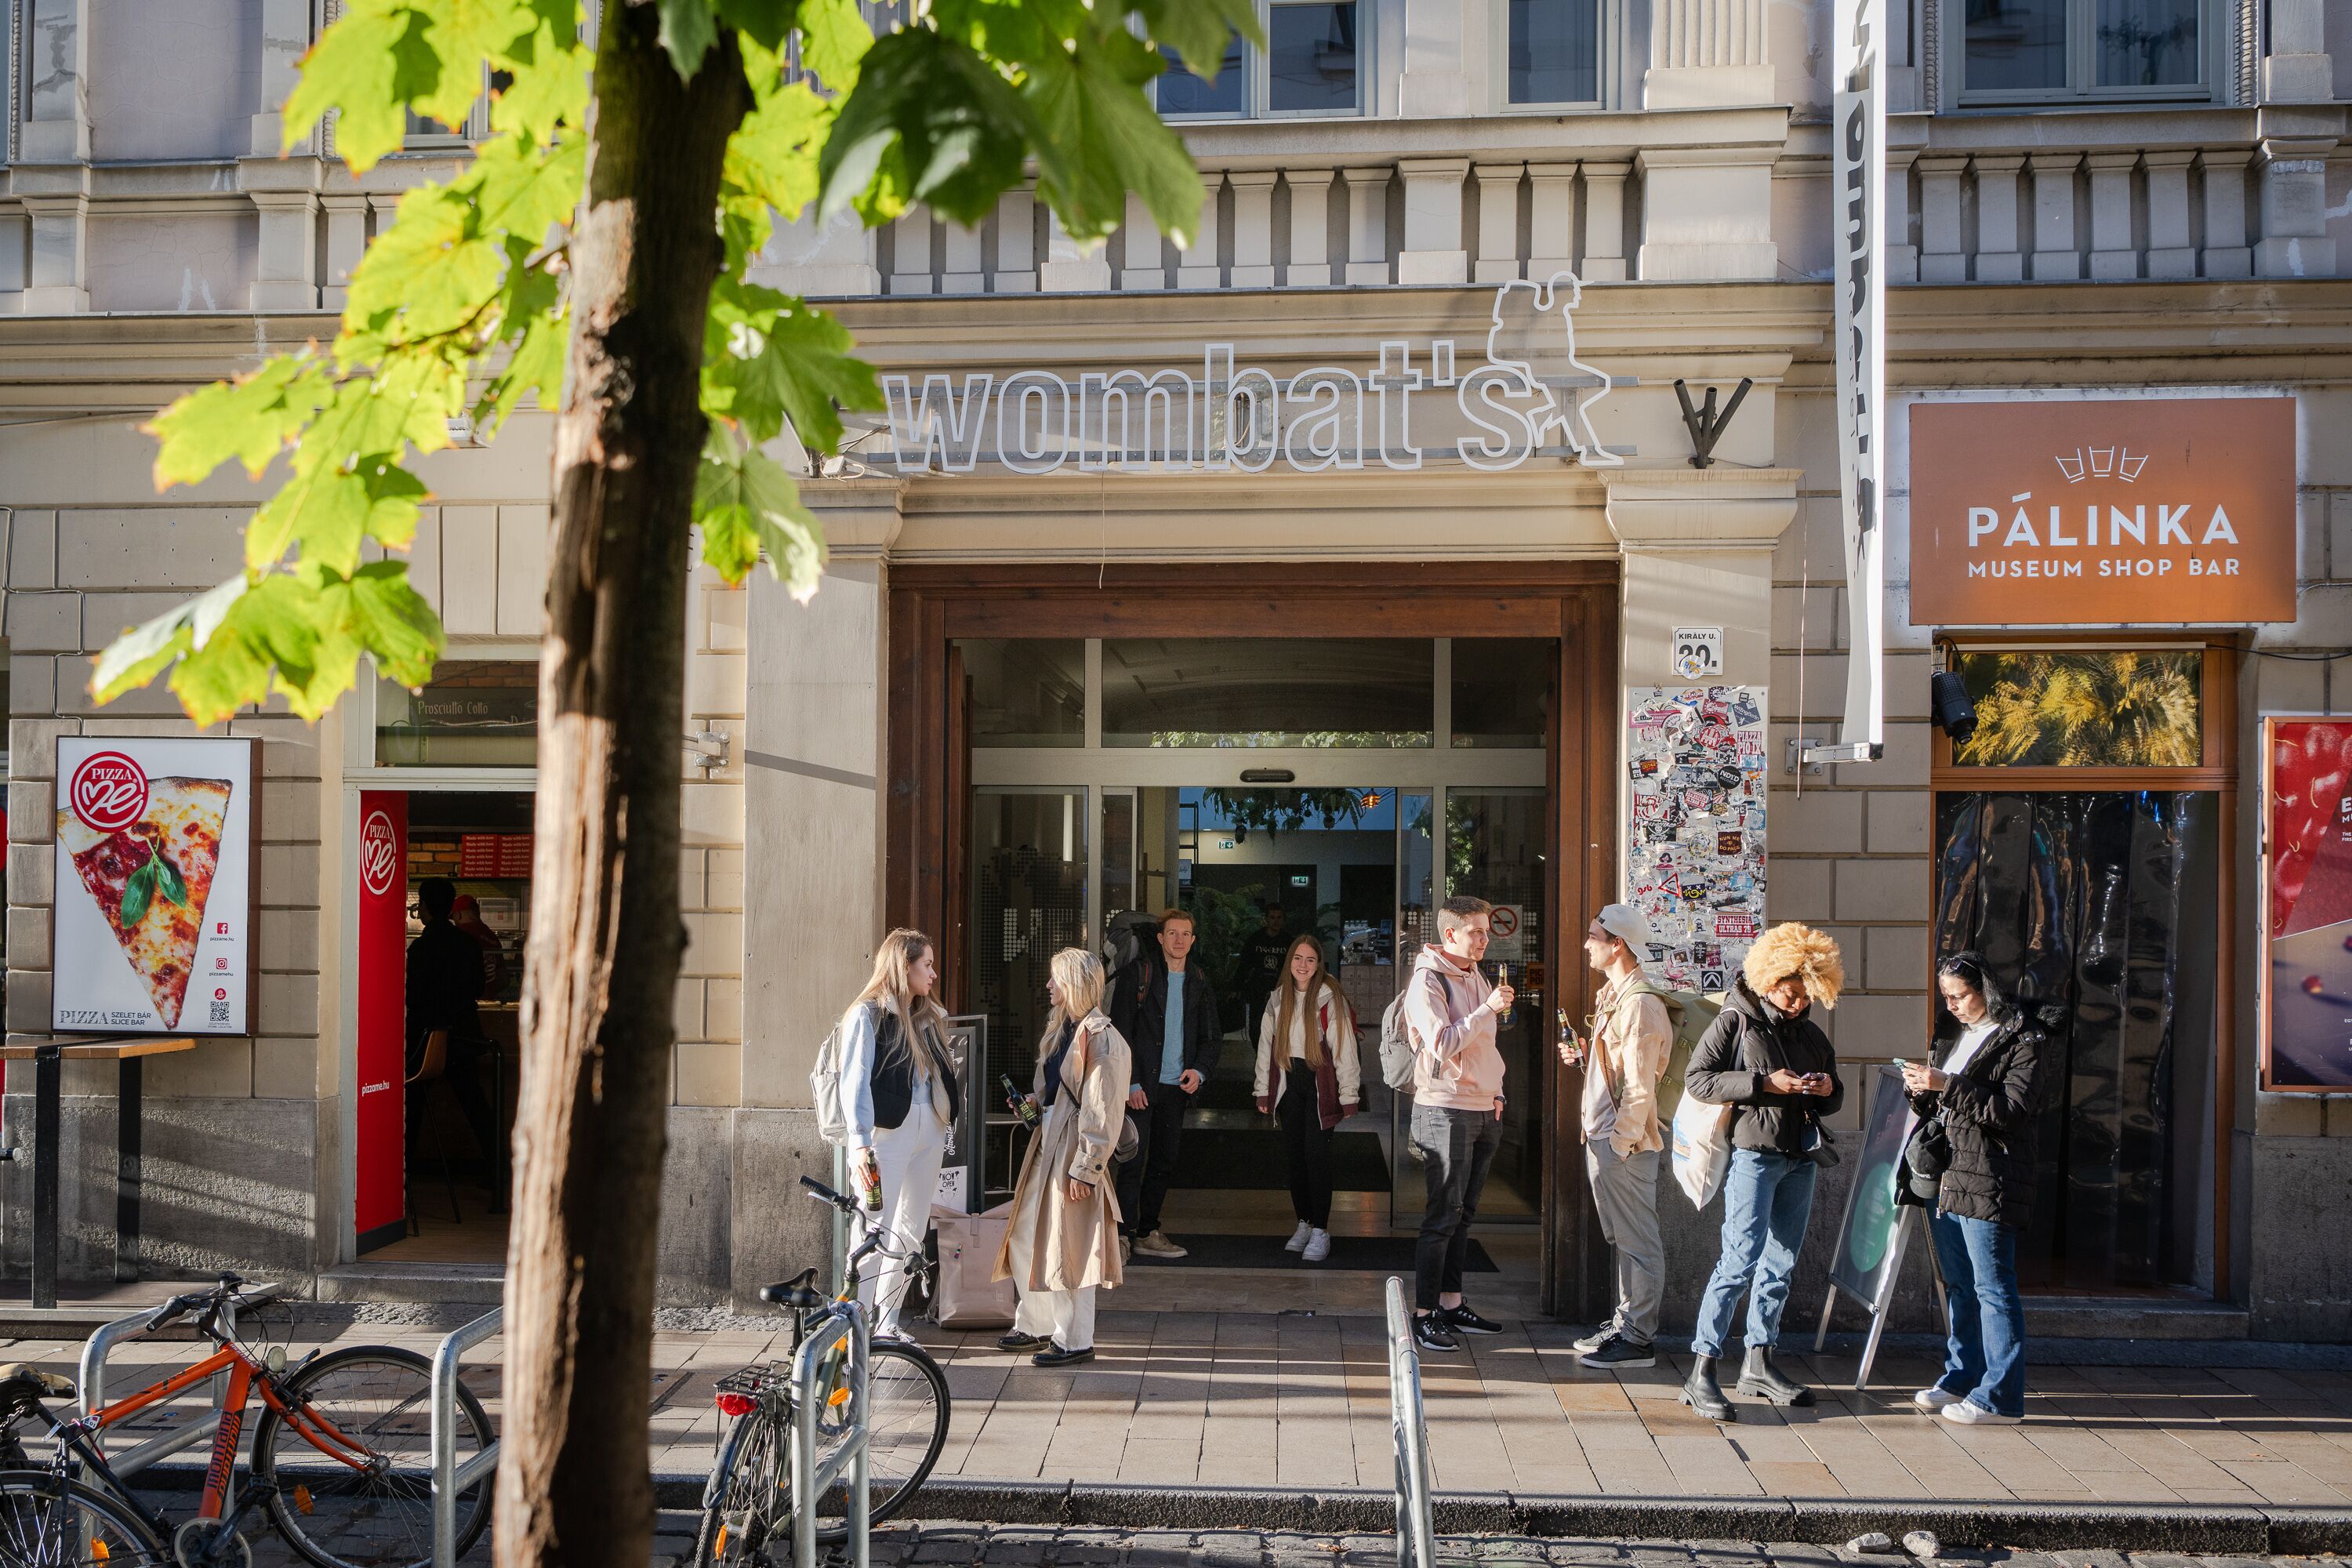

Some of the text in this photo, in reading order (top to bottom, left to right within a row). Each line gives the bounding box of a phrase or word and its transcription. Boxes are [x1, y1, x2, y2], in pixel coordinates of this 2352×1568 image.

[882, 339, 1534, 474] wombat's
[1969, 492, 2239, 547] PÁLINKA
[1969, 558, 2240, 578] MUSEUM SHOP BAR
[1679, 644, 1717, 667] 20.
[1737, 731, 1761, 742] PIAZZA
[1737, 742, 1761, 754] PIO IX
[91, 768, 132, 780] PIZZA
[369, 824, 390, 839] PIZZA
[1717, 915, 1752, 924] SYNTHESIA
[1719, 924, 1751, 933] ULTRAS 79
[60, 1011, 108, 1025] PIZZA
[361, 1080, 390, 1097] pizzame.hu
